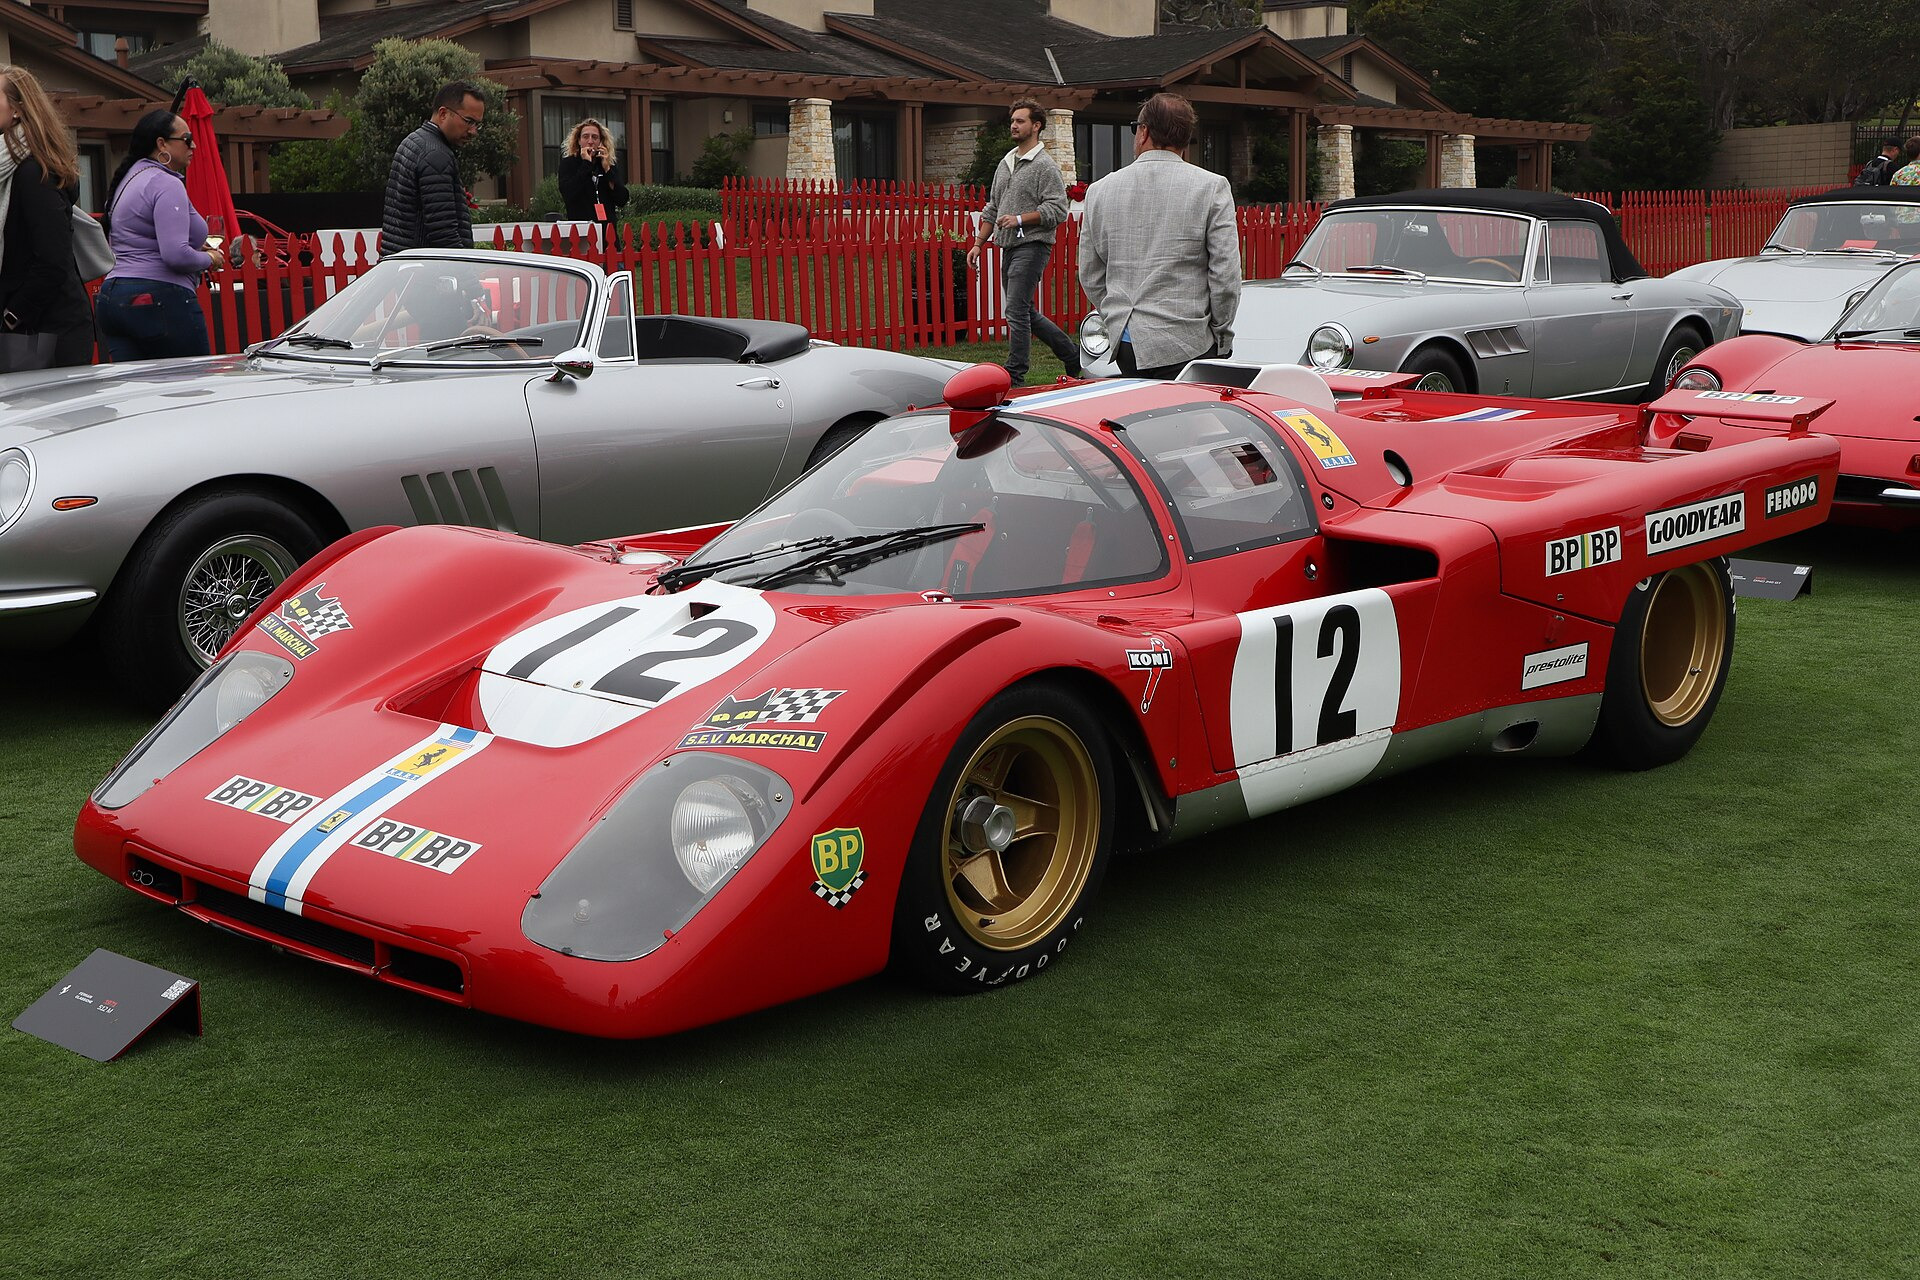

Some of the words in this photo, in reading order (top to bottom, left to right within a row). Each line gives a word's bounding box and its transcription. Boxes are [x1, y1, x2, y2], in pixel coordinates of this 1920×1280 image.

[1703, 391, 1743, 399] BP
[1755, 395, 1797, 403] BP
[1766, 481, 1817, 514] FERODO
[1649, 500, 1742, 545] GOODYEAR
[1550, 541, 1580, 574] BP
[1591, 530, 1618, 565] BP
[260, 616, 280, 632] S.E.V.
[272, 625, 312, 657] MARCHAL
[505, 606, 758, 703] 12
[1129, 652, 1169, 666] KONI
[1524, 654, 1586, 677] prestolite
[1272, 604, 1361, 757] 12
[685, 733, 722, 746] S.E.V.
[726, 733, 816, 748] MARCHAL
[212, 777, 266, 805] BP
[258, 790, 313, 819] BP
[356, 820, 416, 852] BP
[412, 835, 472, 868] BP
[815, 834, 859, 875] BP
